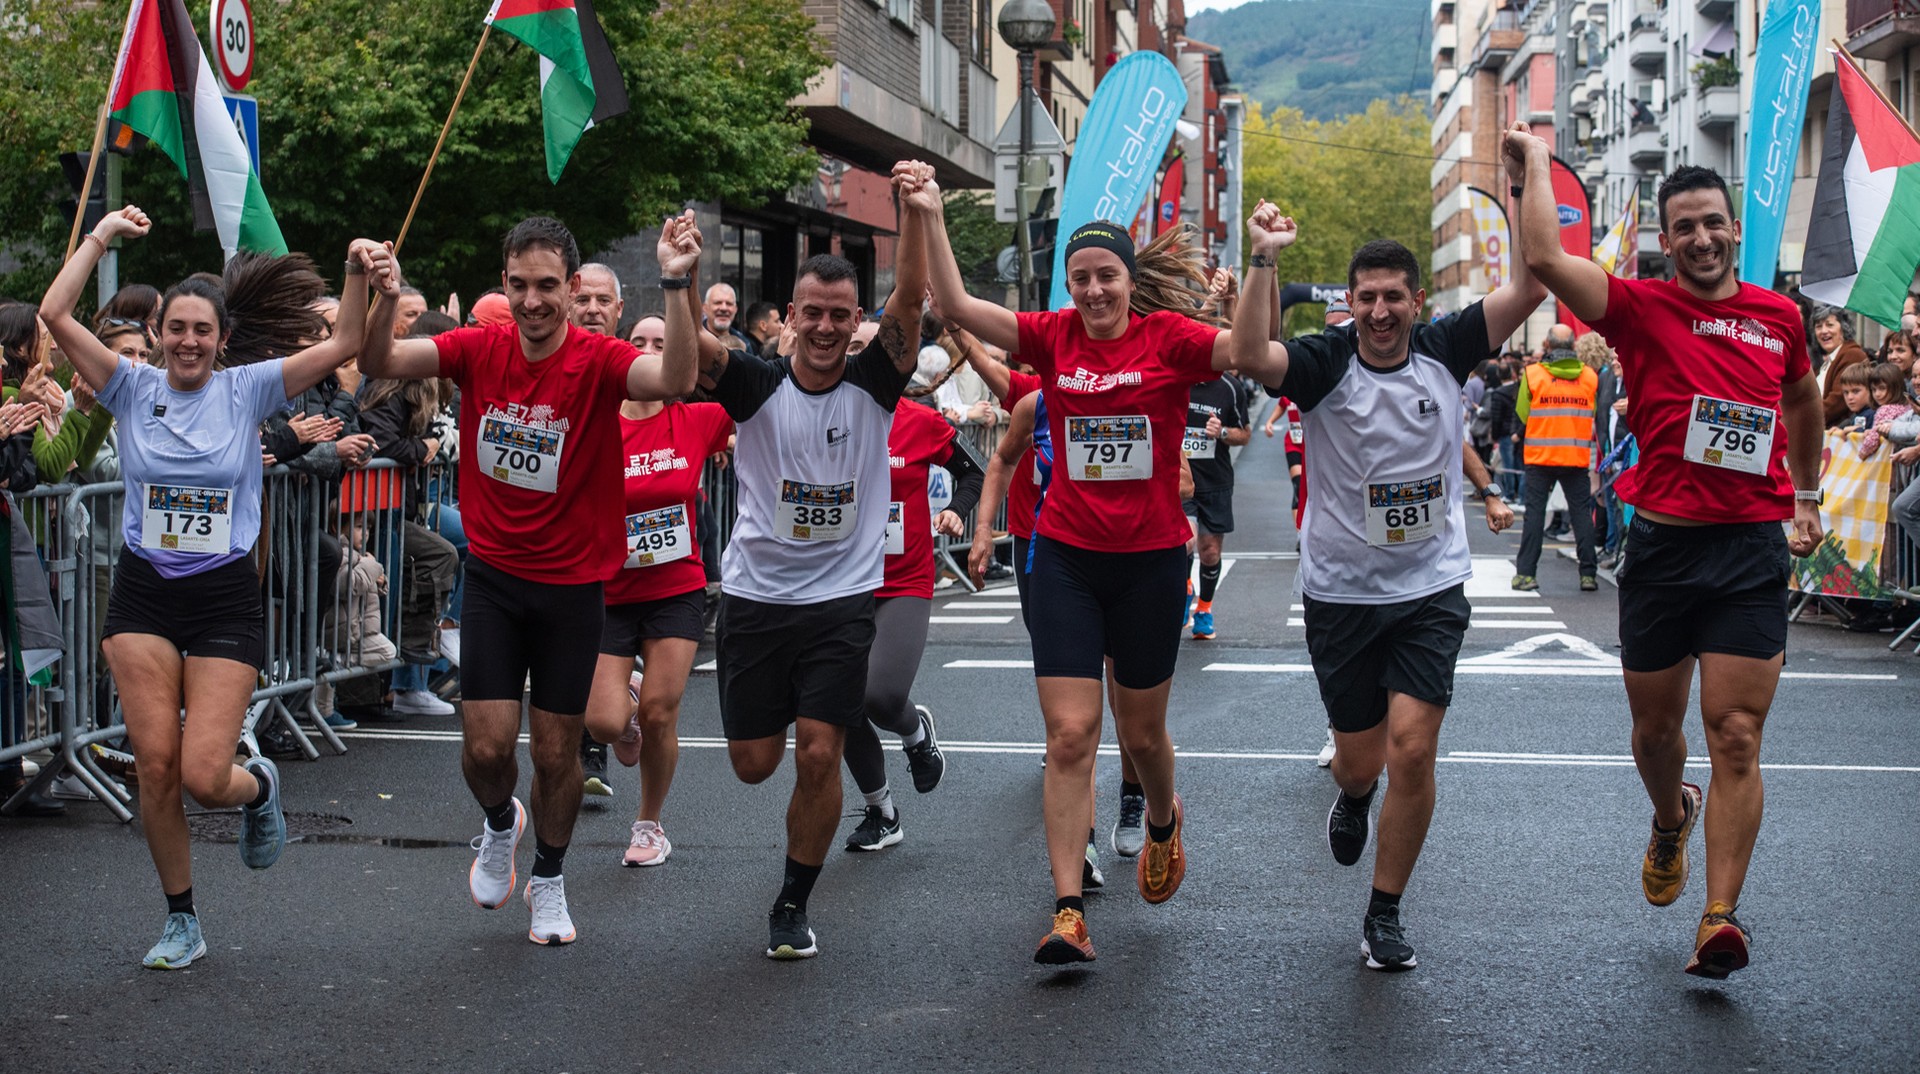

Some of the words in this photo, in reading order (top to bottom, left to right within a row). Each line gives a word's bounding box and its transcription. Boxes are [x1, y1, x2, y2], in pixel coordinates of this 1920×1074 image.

[226, 17, 245, 54] 30
[1094, 86, 1165, 222] ertako
[1073, 230, 1115, 241] LURBEL
[1692, 319, 1763, 348] LASARTE-ORIA
[1075, 367, 1099, 383] 27
[507, 402, 529, 420] 27
[1540, 396, 1588, 406] ANTOLAKUNTZA
[1184, 440, 1208, 451] 505
[1708, 426, 1757, 455] 796
[495, 446, 541, 473] 700
[629, 453, 650, 466] 27
[1083, 443, 1133, 464] 797
[625, 460, 672, 477] SARTE-ORIA
[164, 513, 212, 536] 173
[793, 506, 842, 526] 383
[1385, 504, 1430, 528] 681
[636, 530, 677, 552] 495
